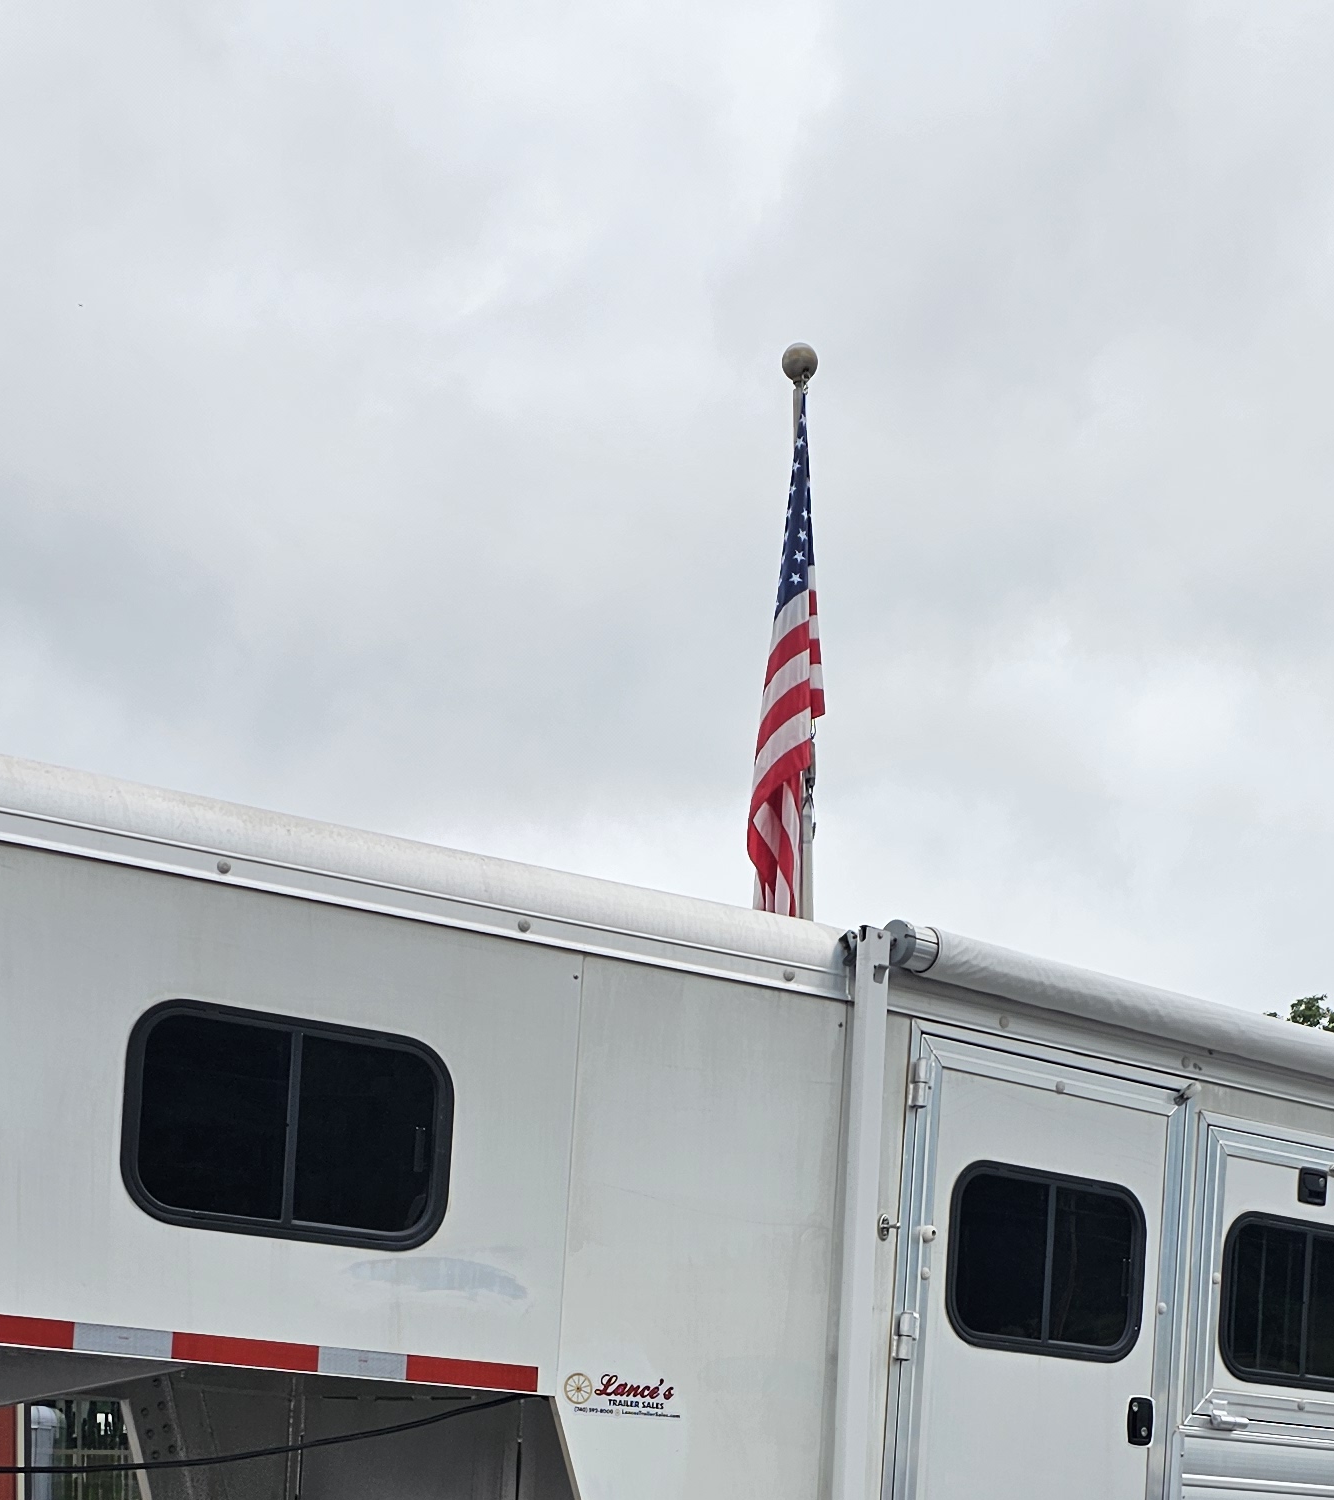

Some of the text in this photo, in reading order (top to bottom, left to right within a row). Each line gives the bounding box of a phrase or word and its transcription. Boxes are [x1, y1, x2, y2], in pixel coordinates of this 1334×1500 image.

[594, 1374, 674, 1400] Lance's
[608, 1399, 664, 1410] TRAILER SALES
